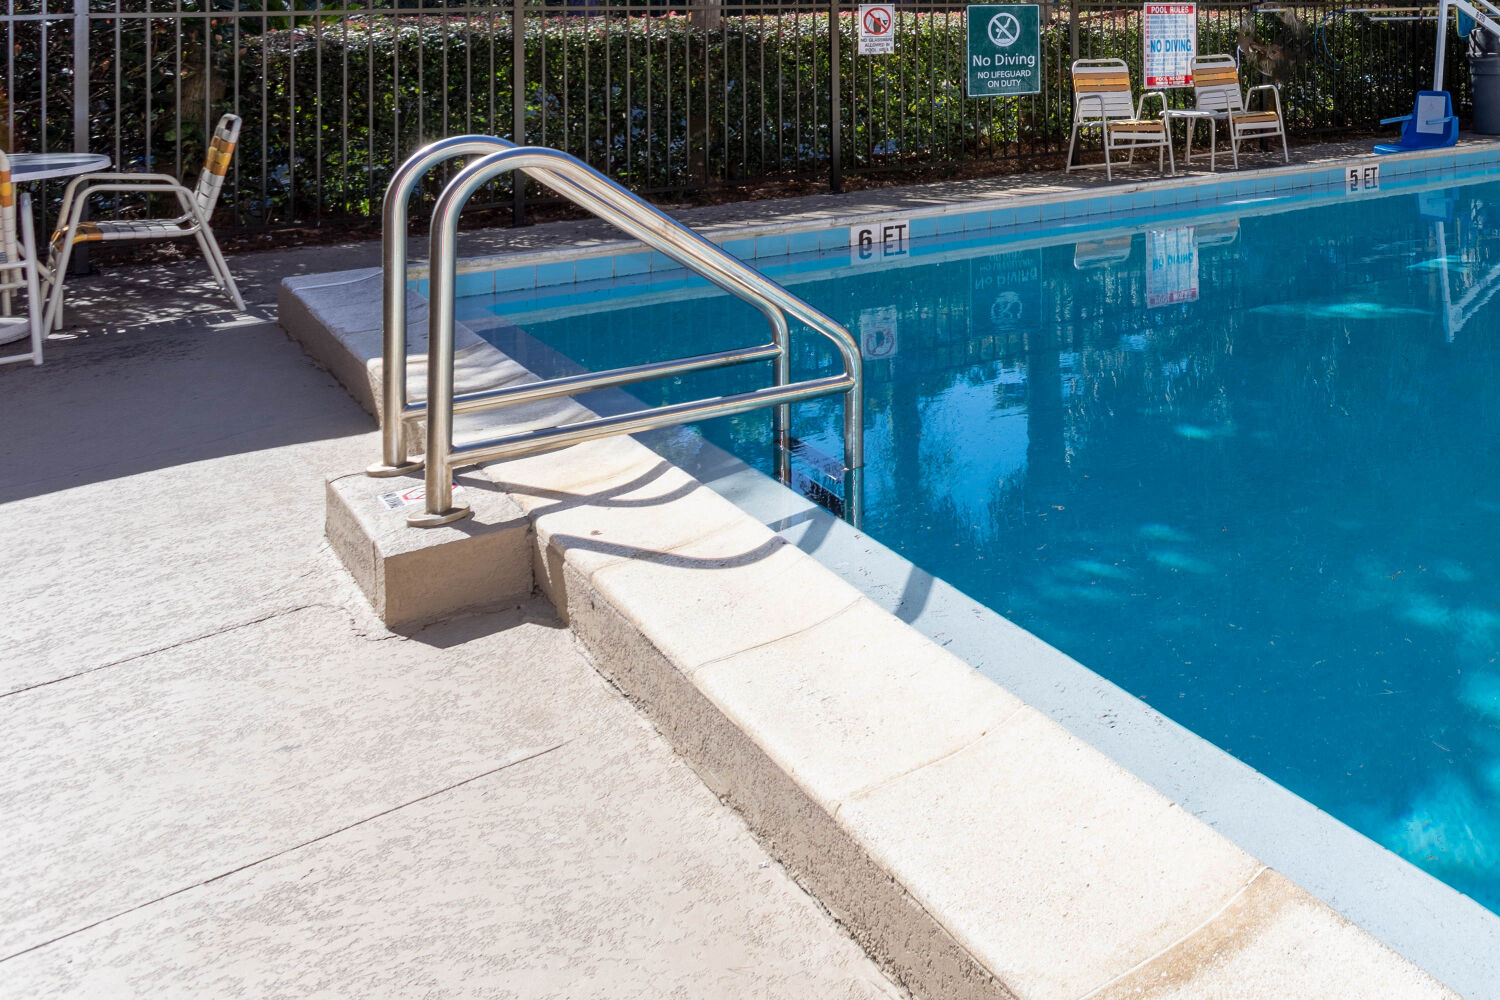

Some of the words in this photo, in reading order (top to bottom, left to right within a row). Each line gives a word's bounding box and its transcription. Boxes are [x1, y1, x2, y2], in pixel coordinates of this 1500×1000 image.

[1150, 40, 1162, 53] NO
[972, 55, 991, 67] No
[995, 53, 1035, 67] Diving
[977, 71, 989, 79] NO
[991, 70, 1031, 78] LIFEGUARD
[987, 80, 999, 88] ON
[1001, 79, 1021, 87] DUTY
[859, 229, 872, 248] 6
